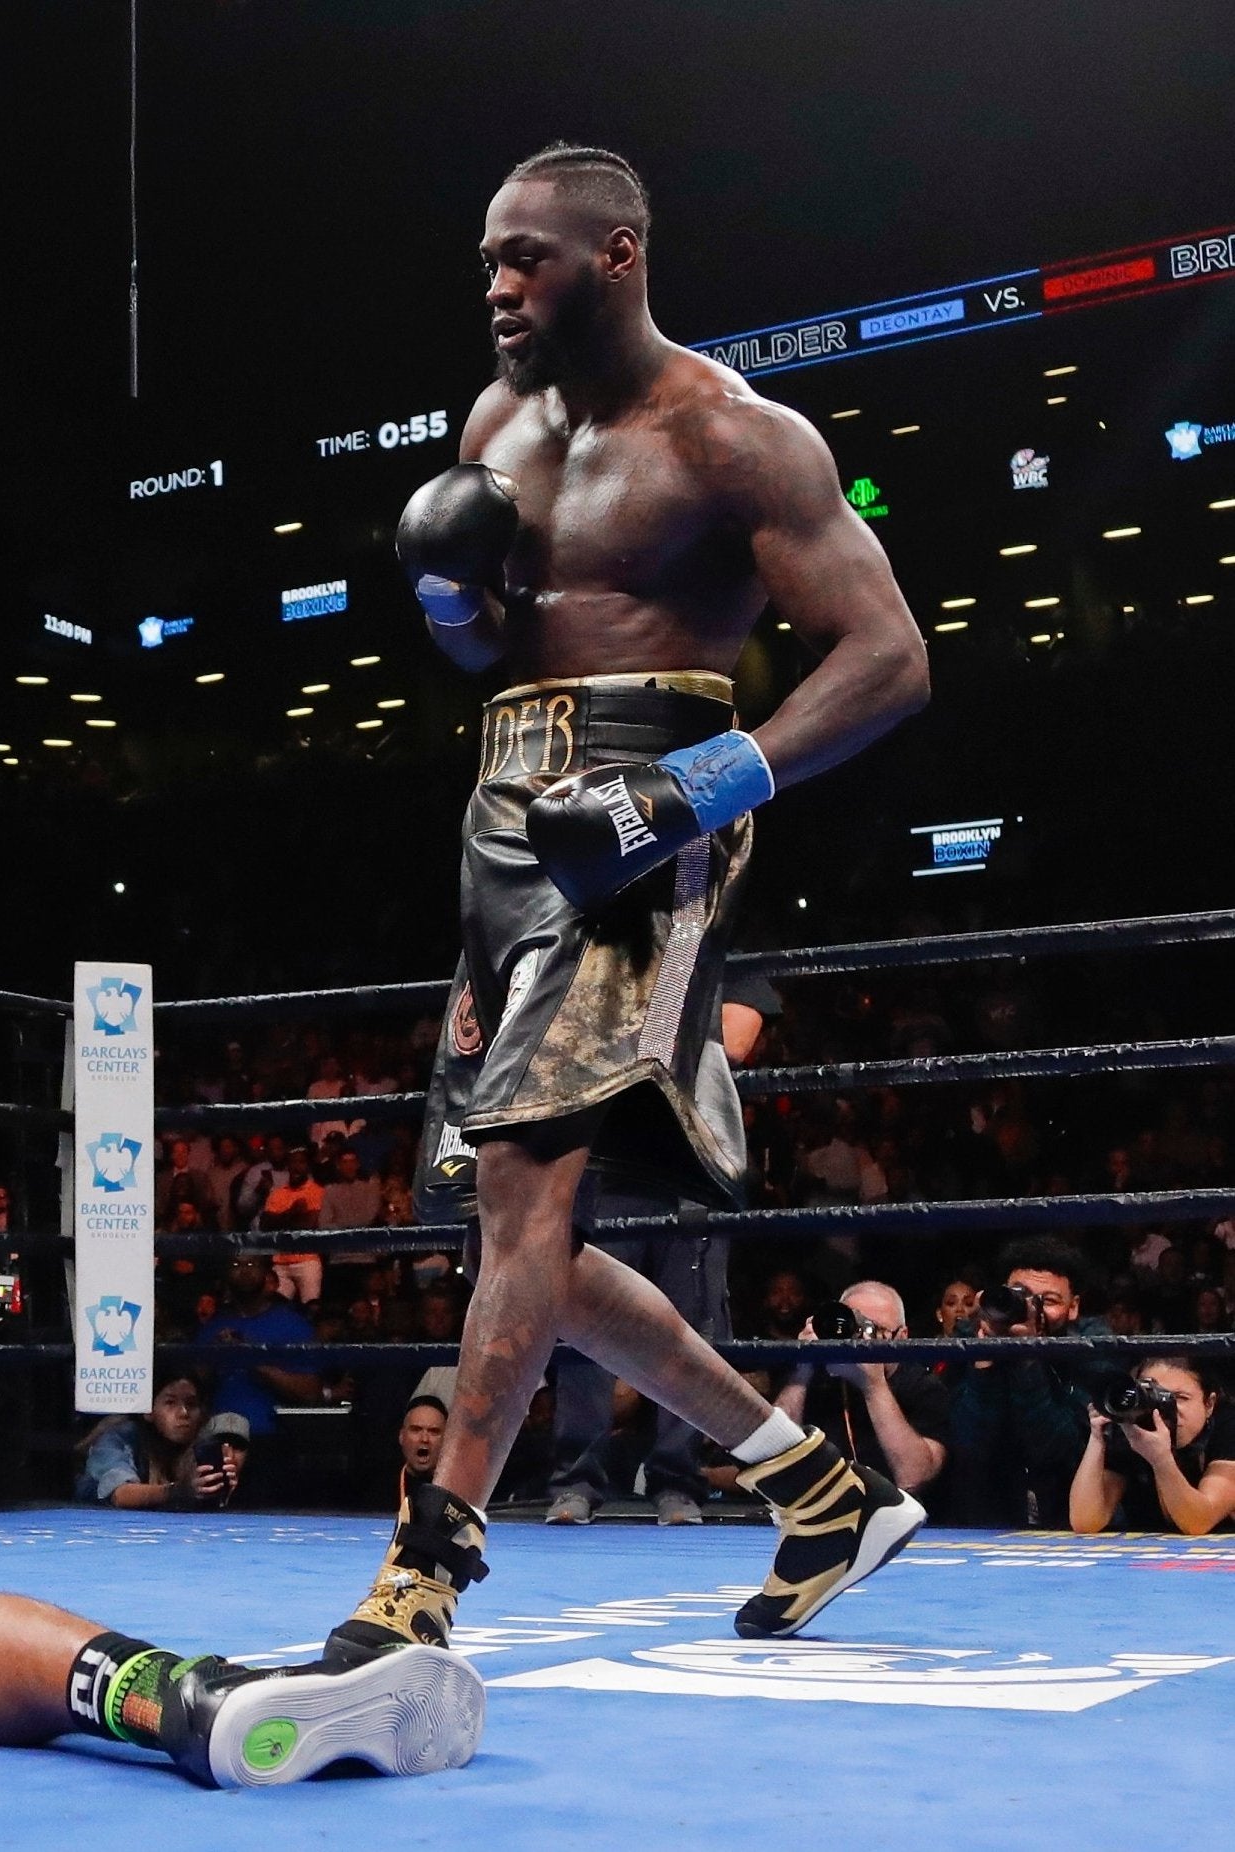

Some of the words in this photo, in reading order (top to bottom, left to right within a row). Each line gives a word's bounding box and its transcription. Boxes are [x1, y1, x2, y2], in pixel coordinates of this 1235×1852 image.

[869, 304, 954, 335] DEONTAY
[983, 286, 1026, 313] VS.
[316, 431, 371, 458] TIME:
[378, 409, 449, 450] 0:55
[129, 467, 206, 499] ROUND:
[209, 459, 224, 487] 1
[1012, 468, 1049, 486] WBC
[281, 579, 348, 604] BROOKLYN
[281, 592, 348, 621] BOXING
[74, 623, 93, 645] PM
[585, 774, 658, 857] EVERLAST
[932, 825, 1001, 846] BROOKLYN
[933, 841, 991, 863] BOXIN
[81, 1046, 148, 1060] BARCLAYS
[87, 1060, 141, 1074] CENTER
[80, 1203, 148, 1216] BARCLAYS
[86, 1217, 140, 1230] CENTER
[79, 1367, 147, 1381] BARCLAYS
[85, 1381, 139, 1395] CENTER
